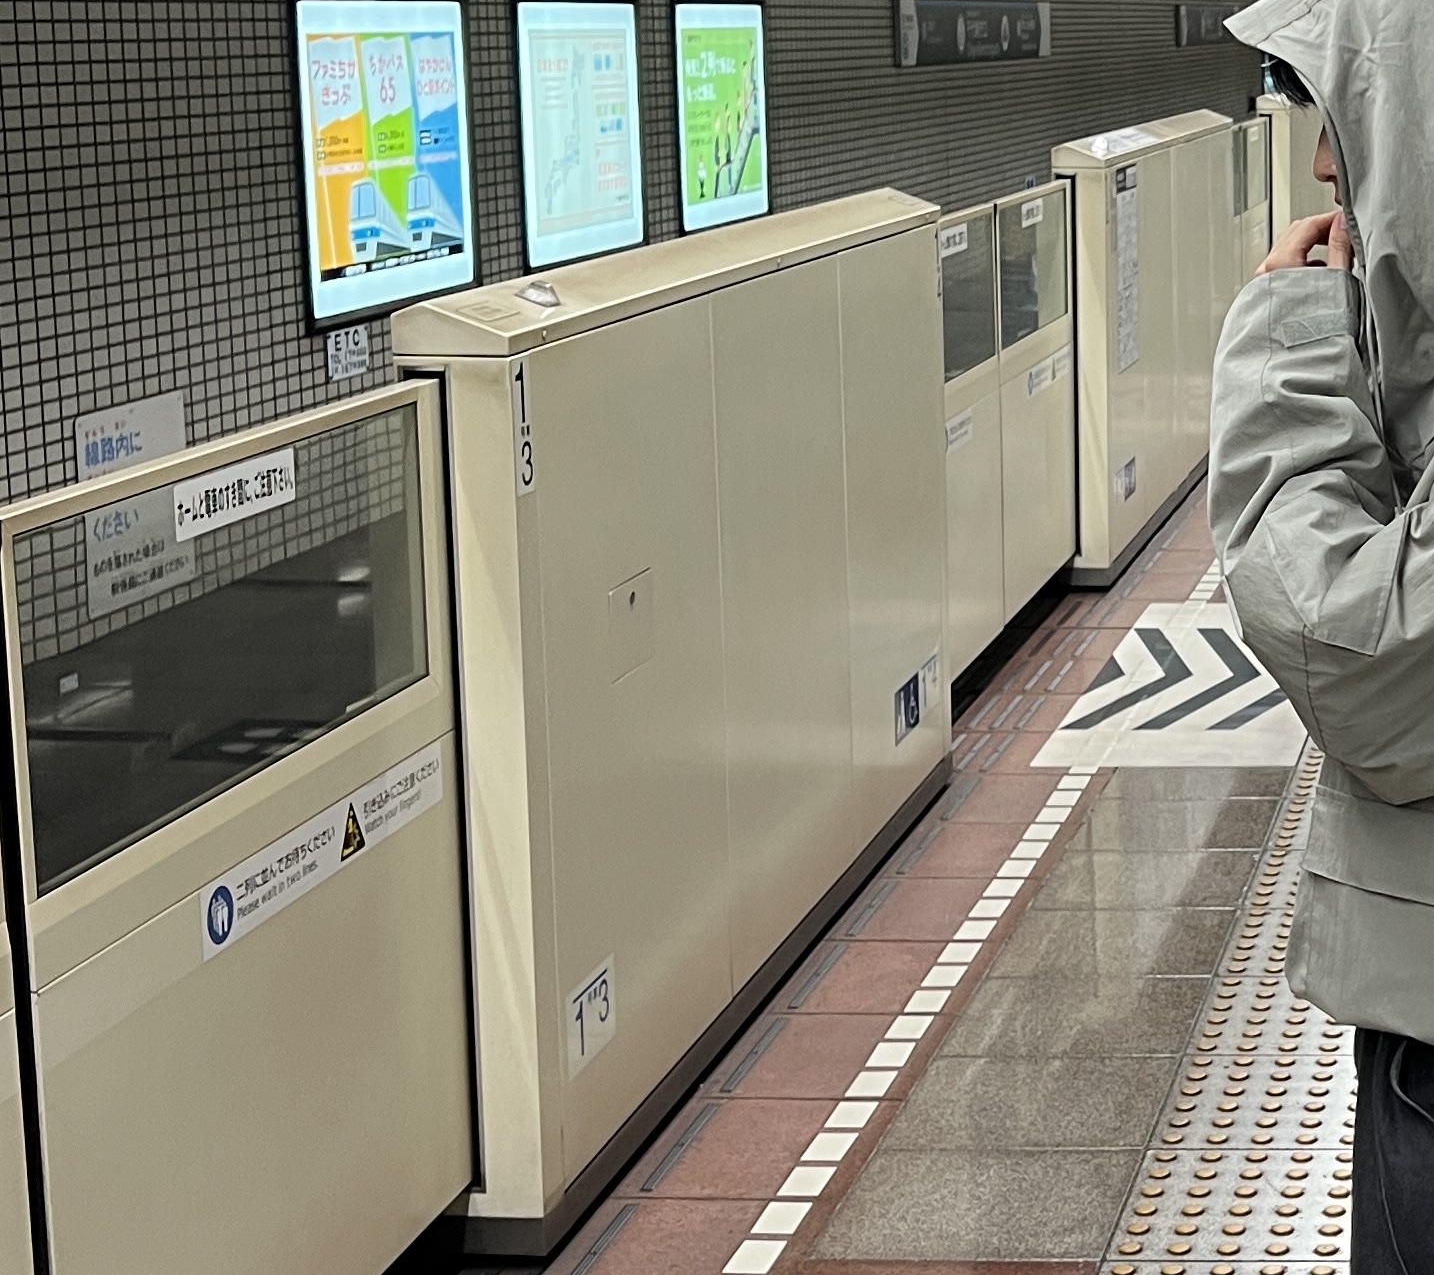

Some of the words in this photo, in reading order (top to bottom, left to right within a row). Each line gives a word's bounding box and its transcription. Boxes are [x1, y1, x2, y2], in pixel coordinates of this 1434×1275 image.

[380, 77, 396, 103] 65
[334, 328, 359, 352] ETC
[515, 362, 525, 423] 1
[521, 441, 533, 486] 3
[93, 508, 140, 543] ください
[575, 1000, 585, 1056] 1
[598, 978, 610, 1022] 3
